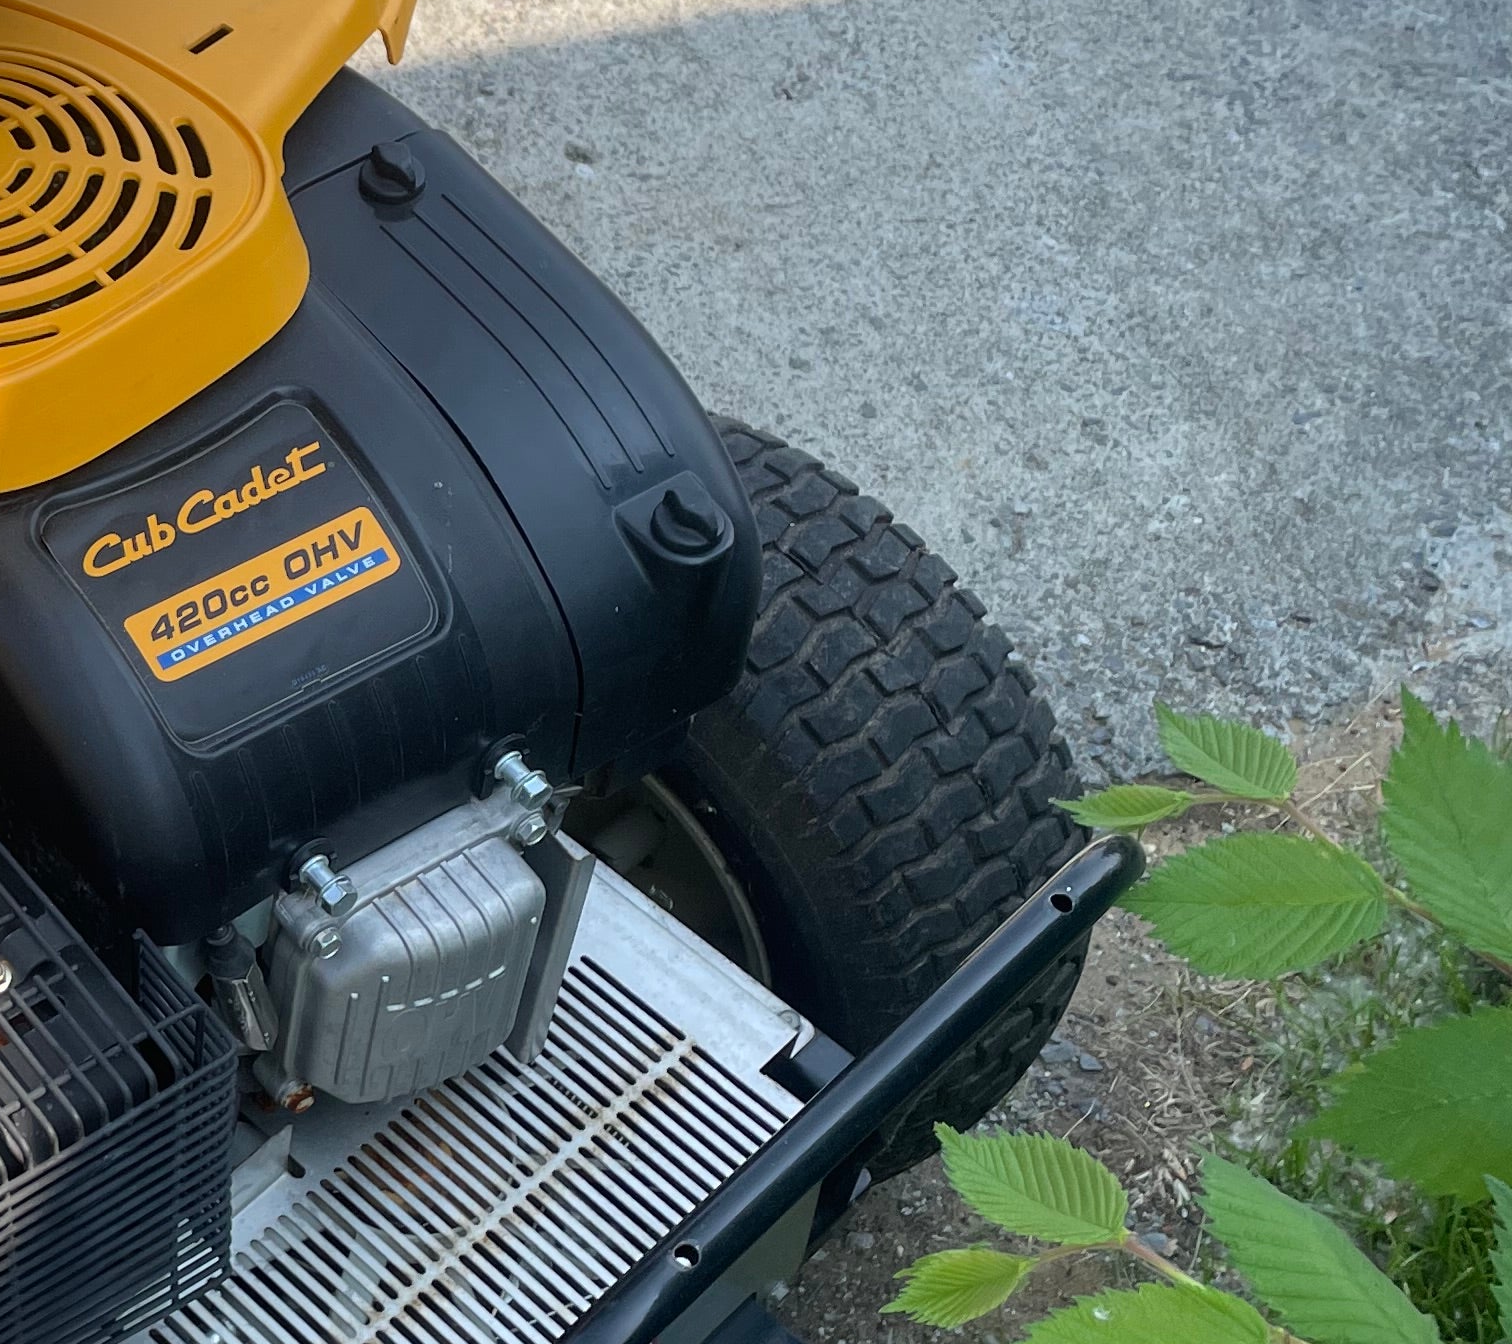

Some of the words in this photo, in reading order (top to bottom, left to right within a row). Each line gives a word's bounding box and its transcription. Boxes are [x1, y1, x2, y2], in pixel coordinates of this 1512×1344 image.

[82, 513, 176, 578] Cub
[176, 440, 327, 535] Cadet
[150, 574, 271, 644] 420cc
[283, 520, 363, 581] OHV
[170, 596, 295, 663] OVERHEAD
[306, 555, 376, 598] VALVE
